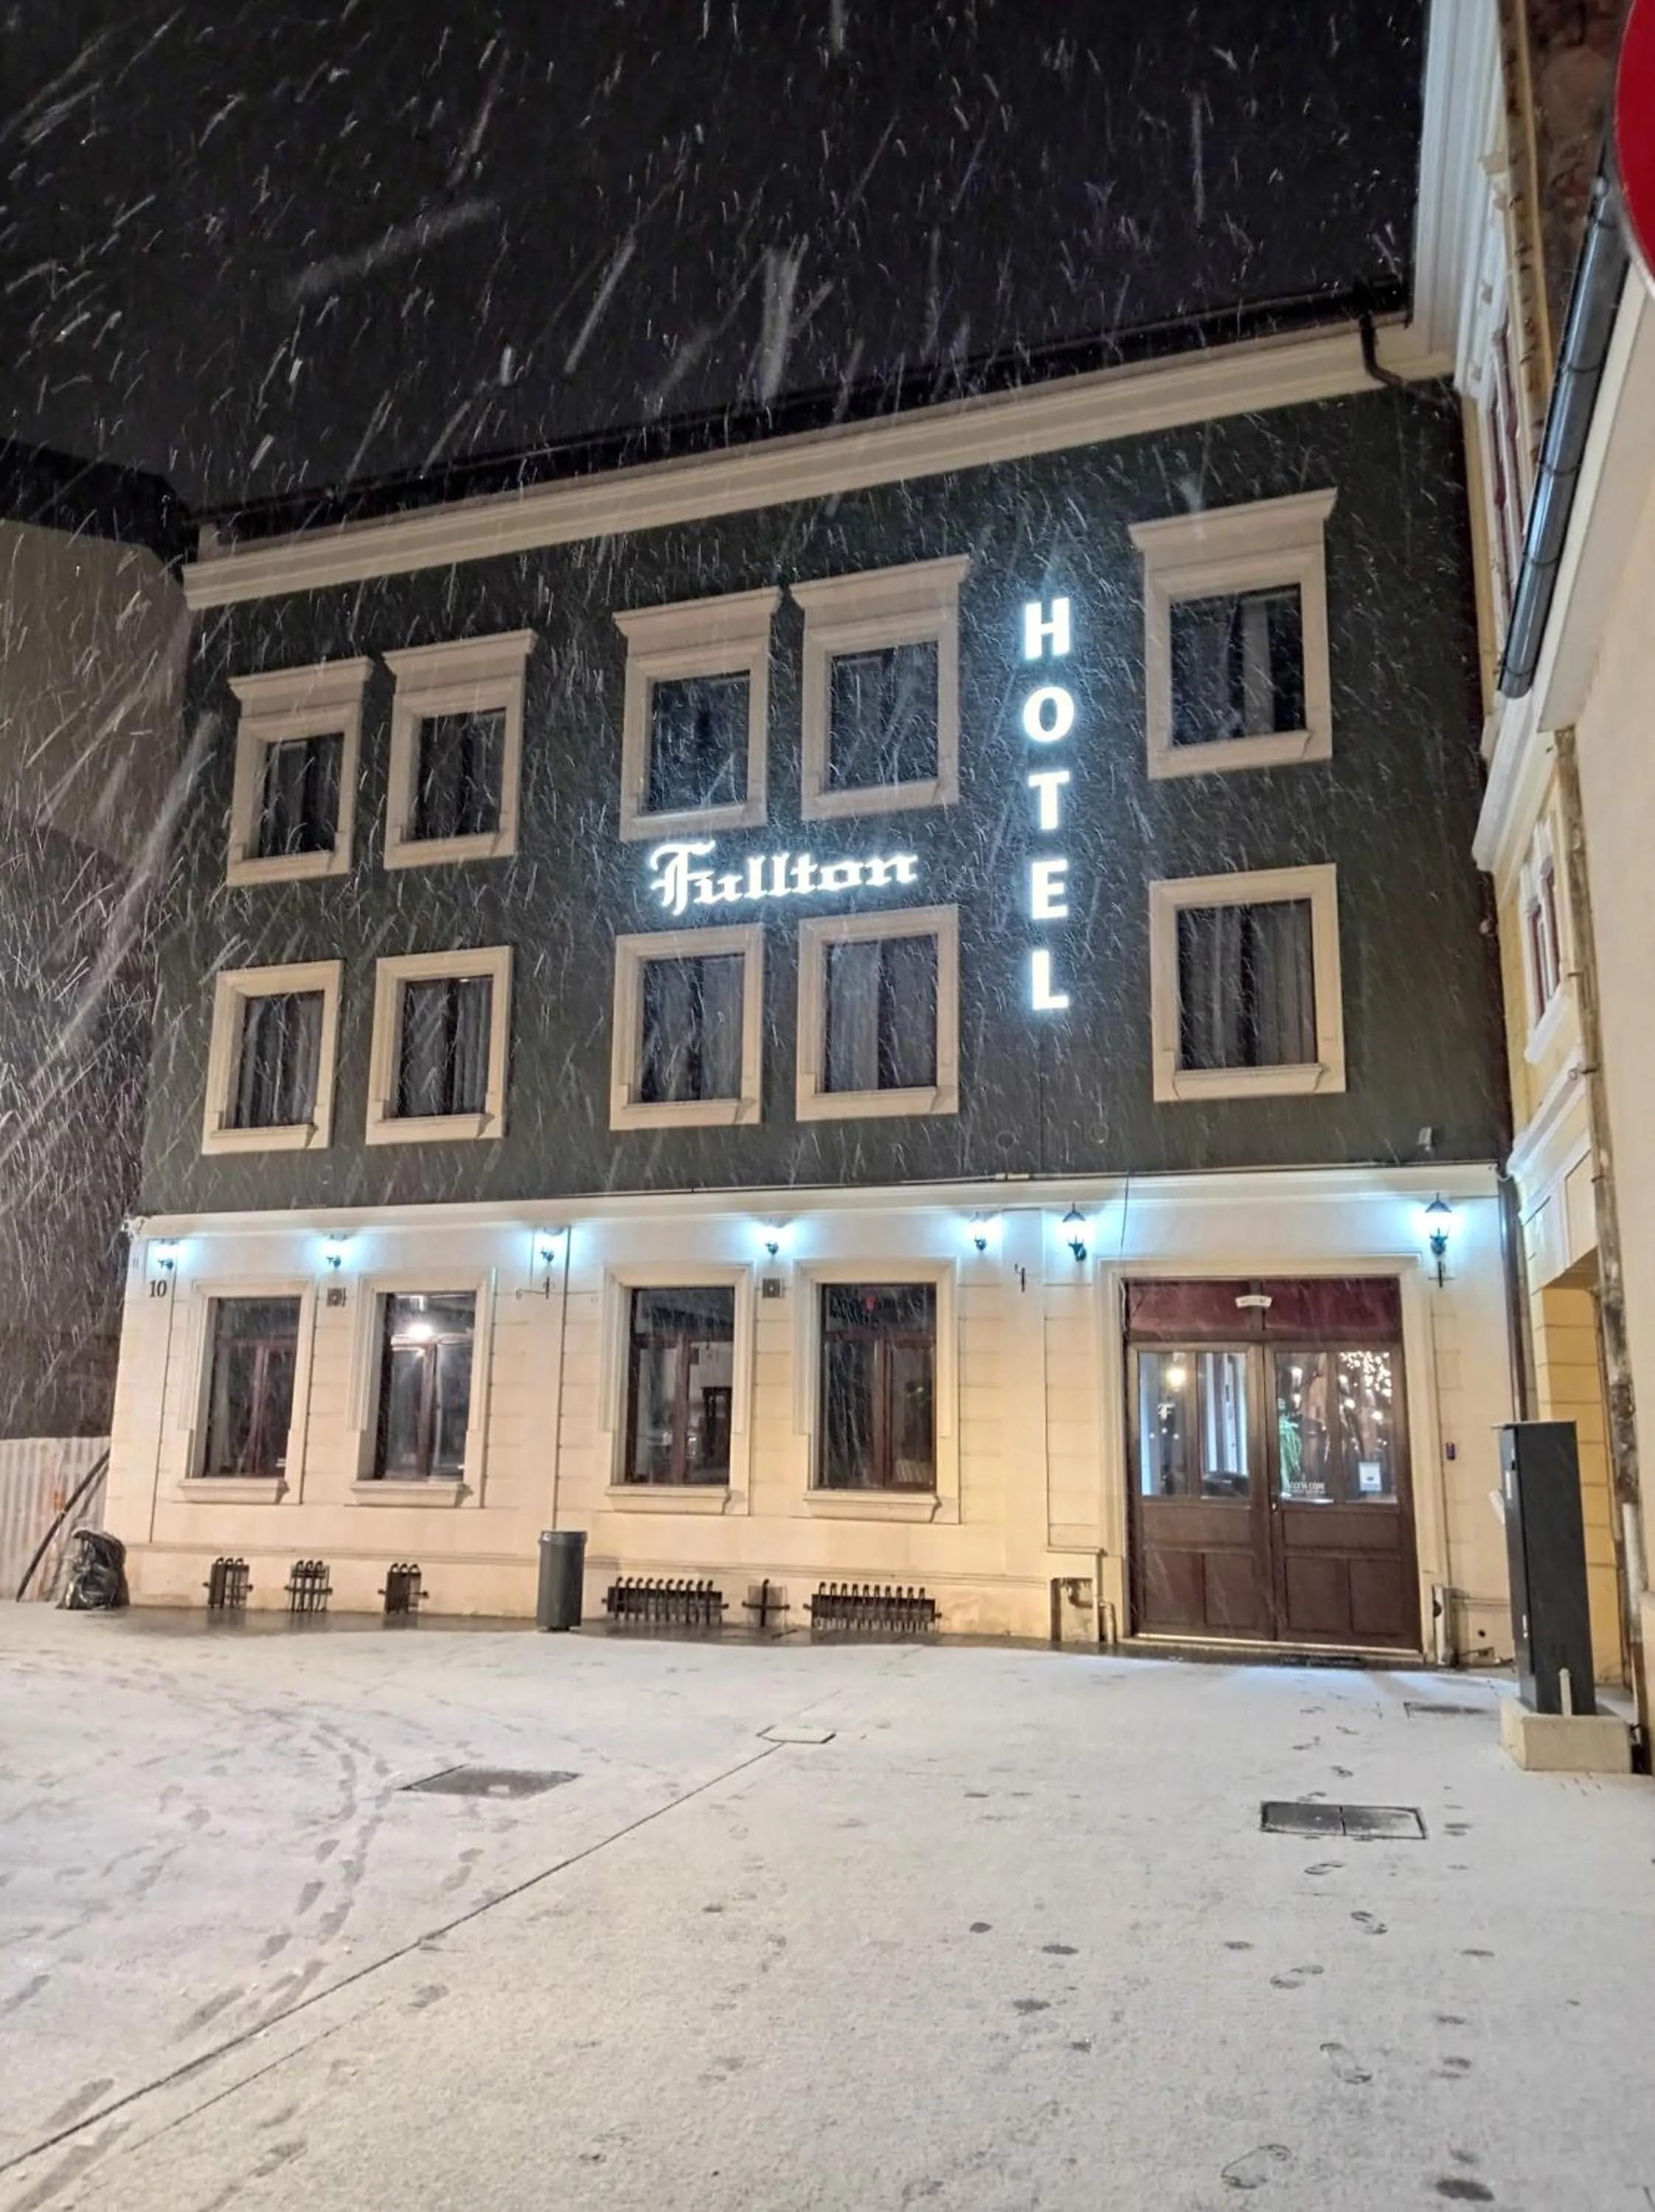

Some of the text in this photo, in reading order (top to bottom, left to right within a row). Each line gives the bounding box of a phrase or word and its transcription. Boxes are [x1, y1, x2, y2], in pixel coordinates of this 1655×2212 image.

[1023, 597, 1075, 1011] HOTEL
[650, 840, 917, 915] Fullton
[149, 1279, 167, 1298] 10
